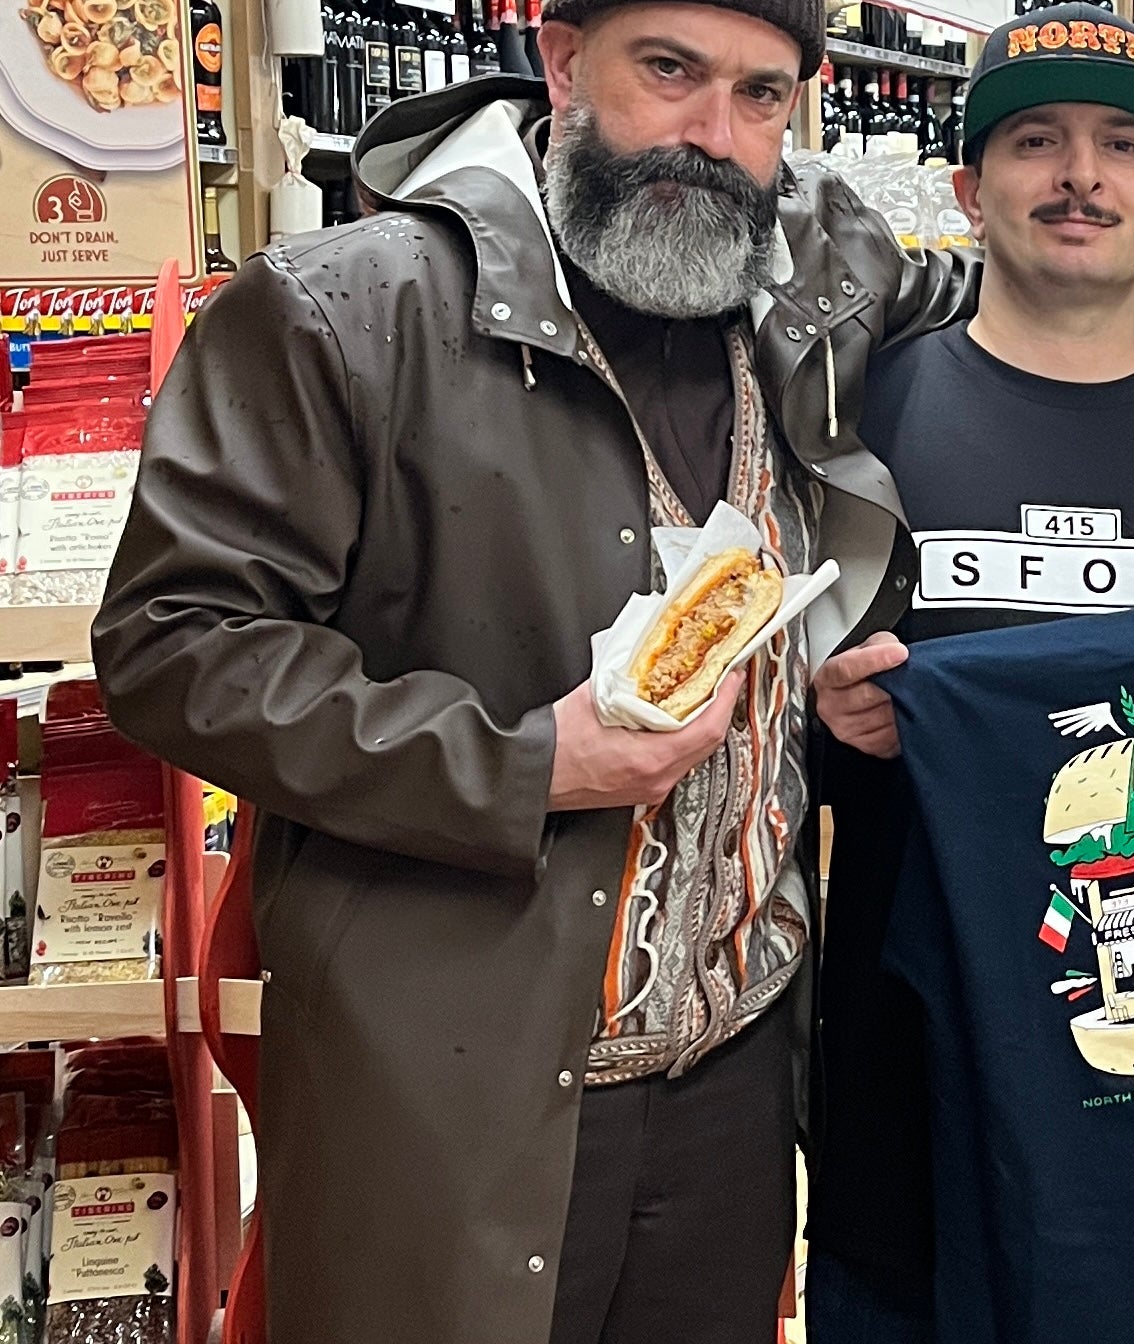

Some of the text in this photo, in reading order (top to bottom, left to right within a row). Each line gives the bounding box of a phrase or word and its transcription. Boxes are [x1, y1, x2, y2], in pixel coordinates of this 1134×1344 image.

[47, 195, 65, 224] 3
[29, 231, 71, 245] DON'T
[40, 249, 110, 264] JUST SERVE
[1044, 514, 1095, 537] 415
[1082, 1092, 1132, 1110] NORTH
